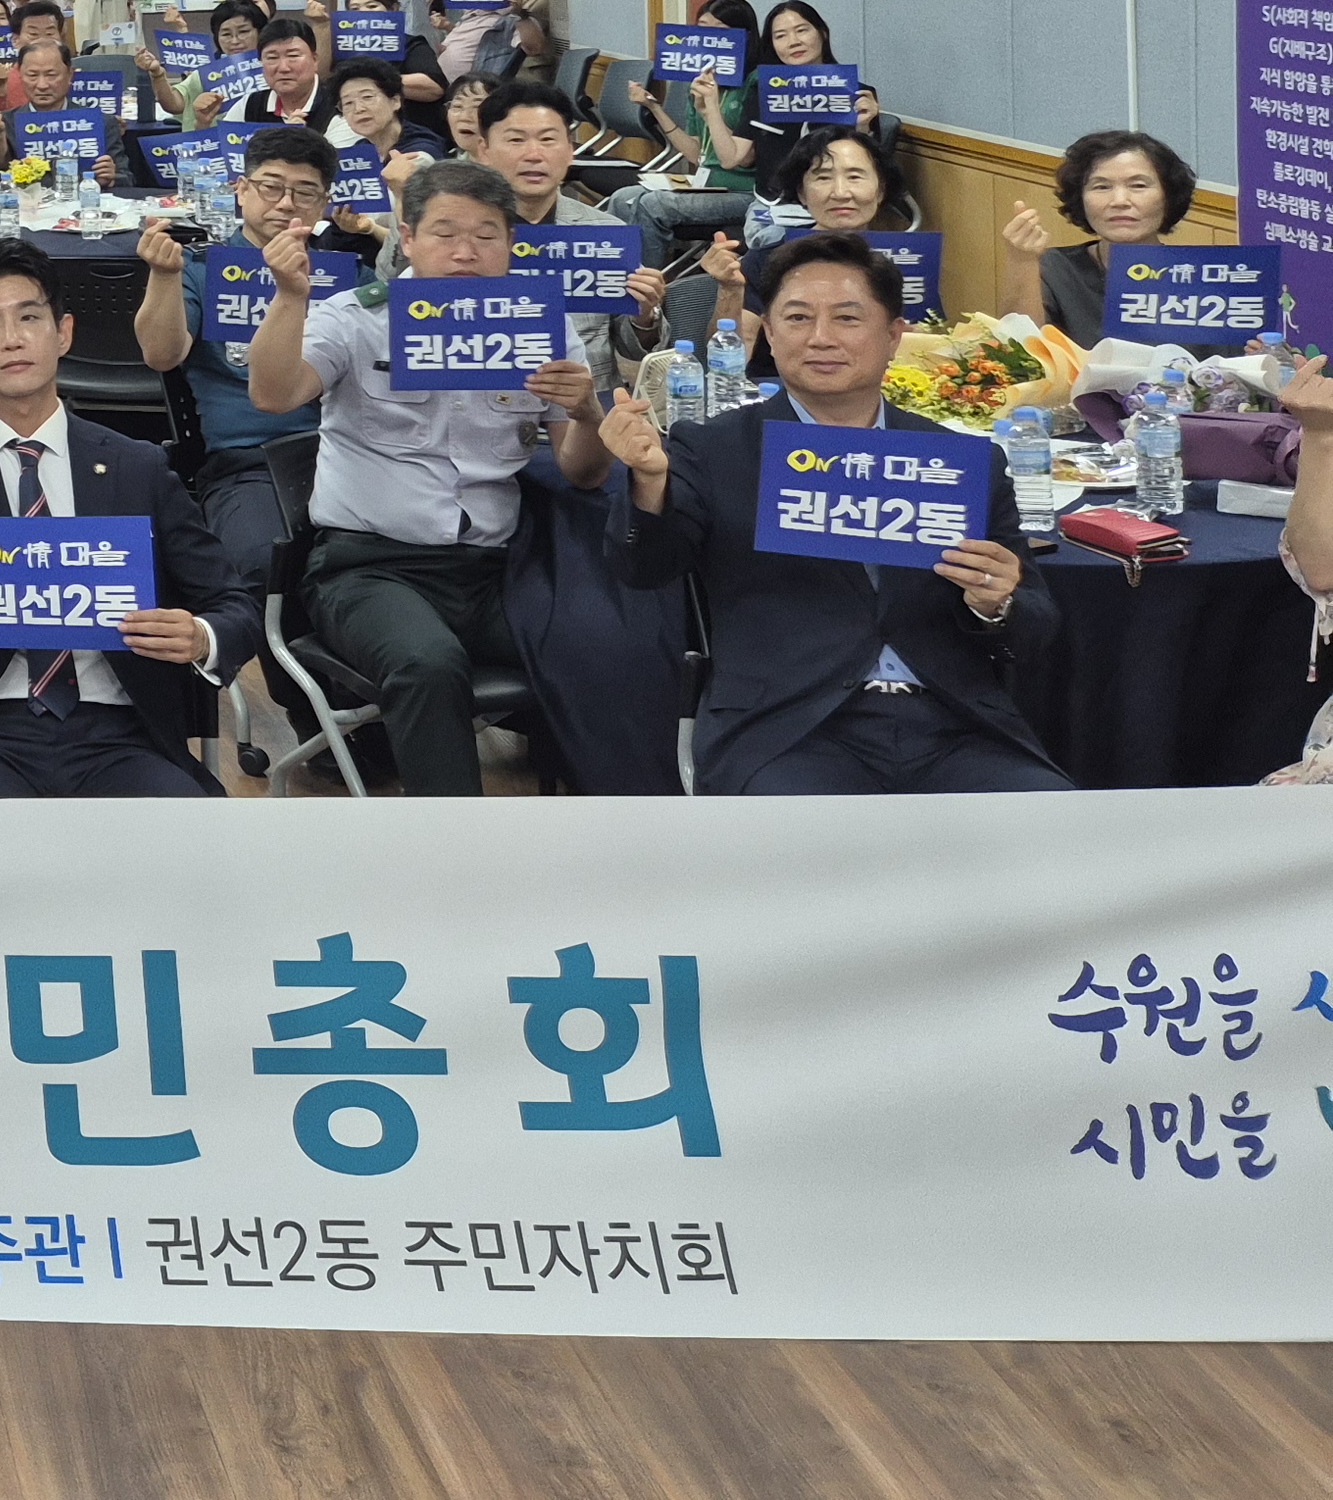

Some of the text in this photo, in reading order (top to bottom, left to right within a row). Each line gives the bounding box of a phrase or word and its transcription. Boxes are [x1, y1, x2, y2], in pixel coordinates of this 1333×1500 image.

[335, 33, 400, 53] 권선2동
[1260, 67, 1281, 88] 지식
[1283, 70, 1318, 93] 함양을
[765, 92, 853, 114] 권선2동
[1250, 96, 1304, 123] 지속가능한
[1265, 128, 1309, 155] 환경시설
[1256, 189, 1321, 221] 탄소중립활동
[1264, 220, 1319, 252] 심폐소생술
[1118, 291, 1265, 330] 권선2동
[404, 332, 553, 371] 권선2동
[777, 488, 969, 547] 권선2동
[1047, 952, 1264, 1064] 수원을
[1069, 1090, 1278, 1180] 시민을
[144, 1214, 380, 1292] 권선2동
[401, 1219, 739, 1296] 주민자치회
